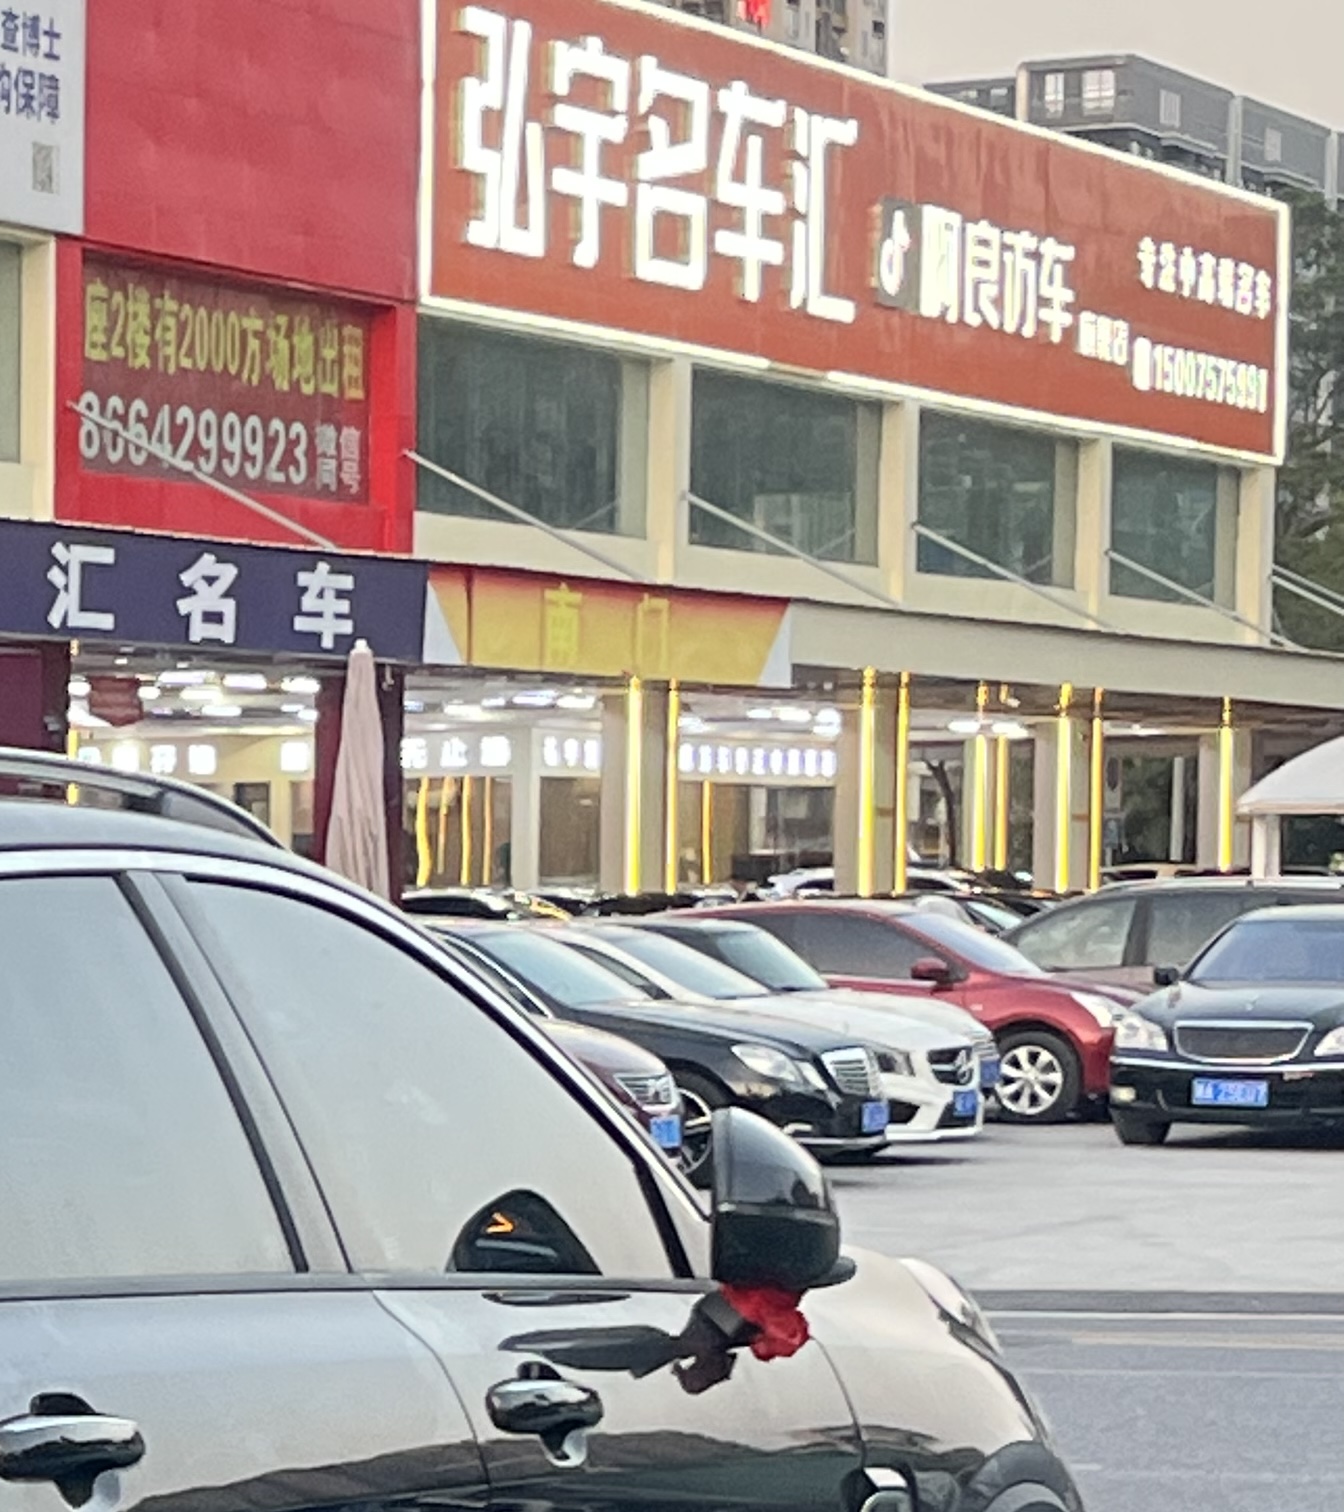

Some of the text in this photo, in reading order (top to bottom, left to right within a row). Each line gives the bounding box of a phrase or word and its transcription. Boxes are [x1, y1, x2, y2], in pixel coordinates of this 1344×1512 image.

[459, 5, 858, 325] 弘宇名车汇
[78, 391, 308, 485] 8664299923
